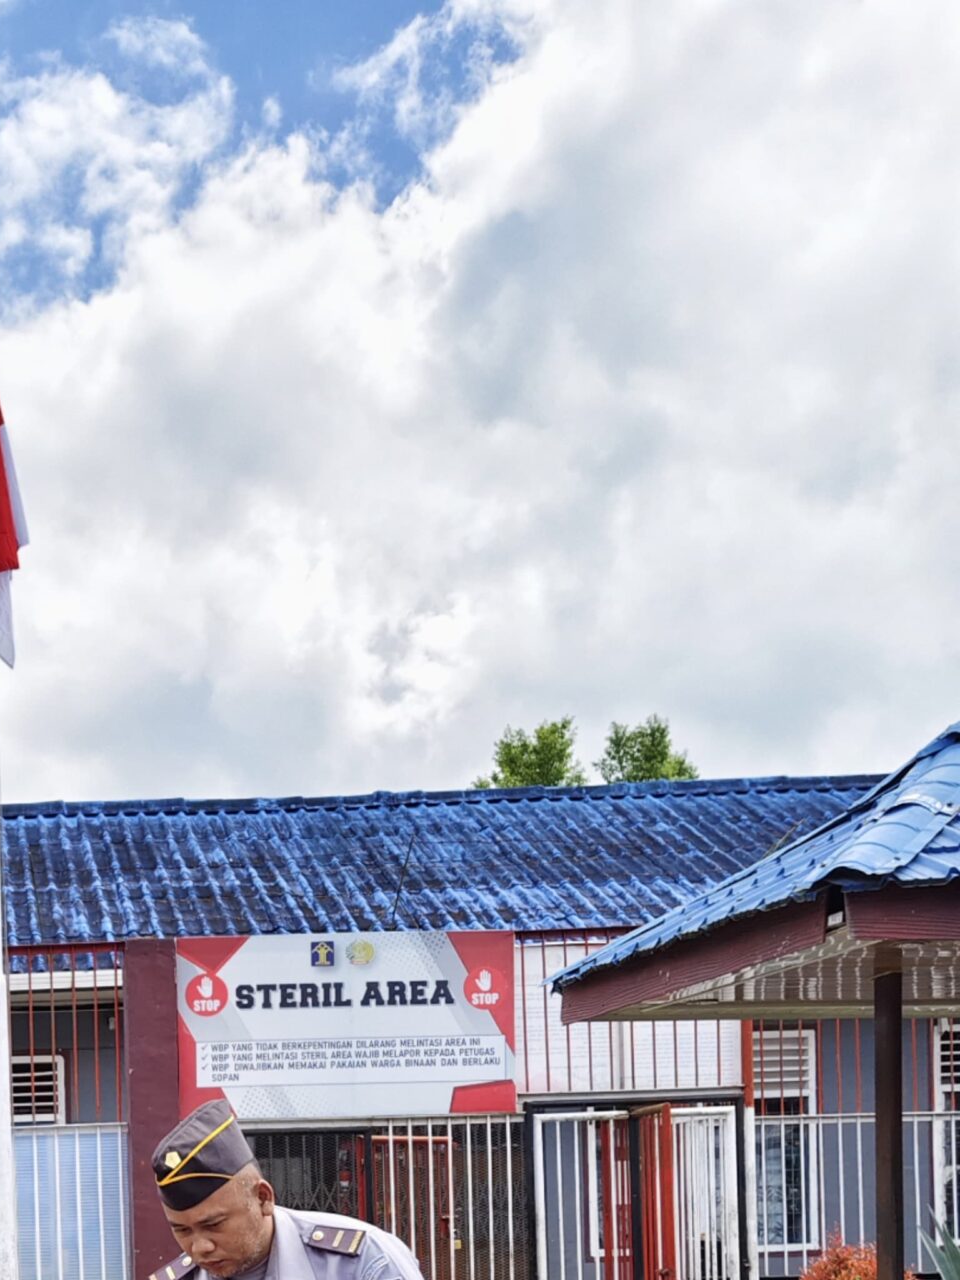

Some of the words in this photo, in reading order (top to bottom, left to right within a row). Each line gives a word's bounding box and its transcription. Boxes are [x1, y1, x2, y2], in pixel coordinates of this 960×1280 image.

[235, 982, 352, 1009] STERIL
[360, 980, 455, 1006] AREA
[472, 993, 500, 1005] STOP
[193, 999, 221, 1012] STOP
[211, 1043, 229, 1052] WBP
[231, 1043, 253, 1051] YANG
[255, 1042, 278, 1051] TIDAK
[281, 1041, 353, 1050] BERKEPENTINGAN
[356, 1040, 397, 1049] DILARANG
[400, 1039, 442, 1047] MELINTASI
[445, 1038, 467, 1046] AREA
[469, 1038, 481, 1046] INI
[211, 1053, 229, 1062] WBP
[231, 1053, 253, 1061] YANG
[255, 1052, 298, 1061] MELINTASI
[301, 1051, 328, 1060] STERIL
[330, 1051, 352, 1059] AREA
[354, 1050, 380, 1058] WAJIB
[382, 1049, 421, 1058] MELAPOR
[423, 1048, 455, 1057] KEPADA
[459, 1047, 496, 1056] PETUGAS
[211, 1063, 229, 1072] WBP
[234, 1062, 284, 1071] DIWAJIBKAN
[287, 1061, 327, 1070] MEMAKAI
[330, 1060, 367, 1069] PAKAIAN
[370, 1059, 402, 1068] WARGA
[405, 1058, 437, 1067] BINAAN
[440, 1058, 459, 1066] DAN
[462, 1057, 501, 1066] BERLAKU
[211, 1073, 240, 1082] SOPAN
